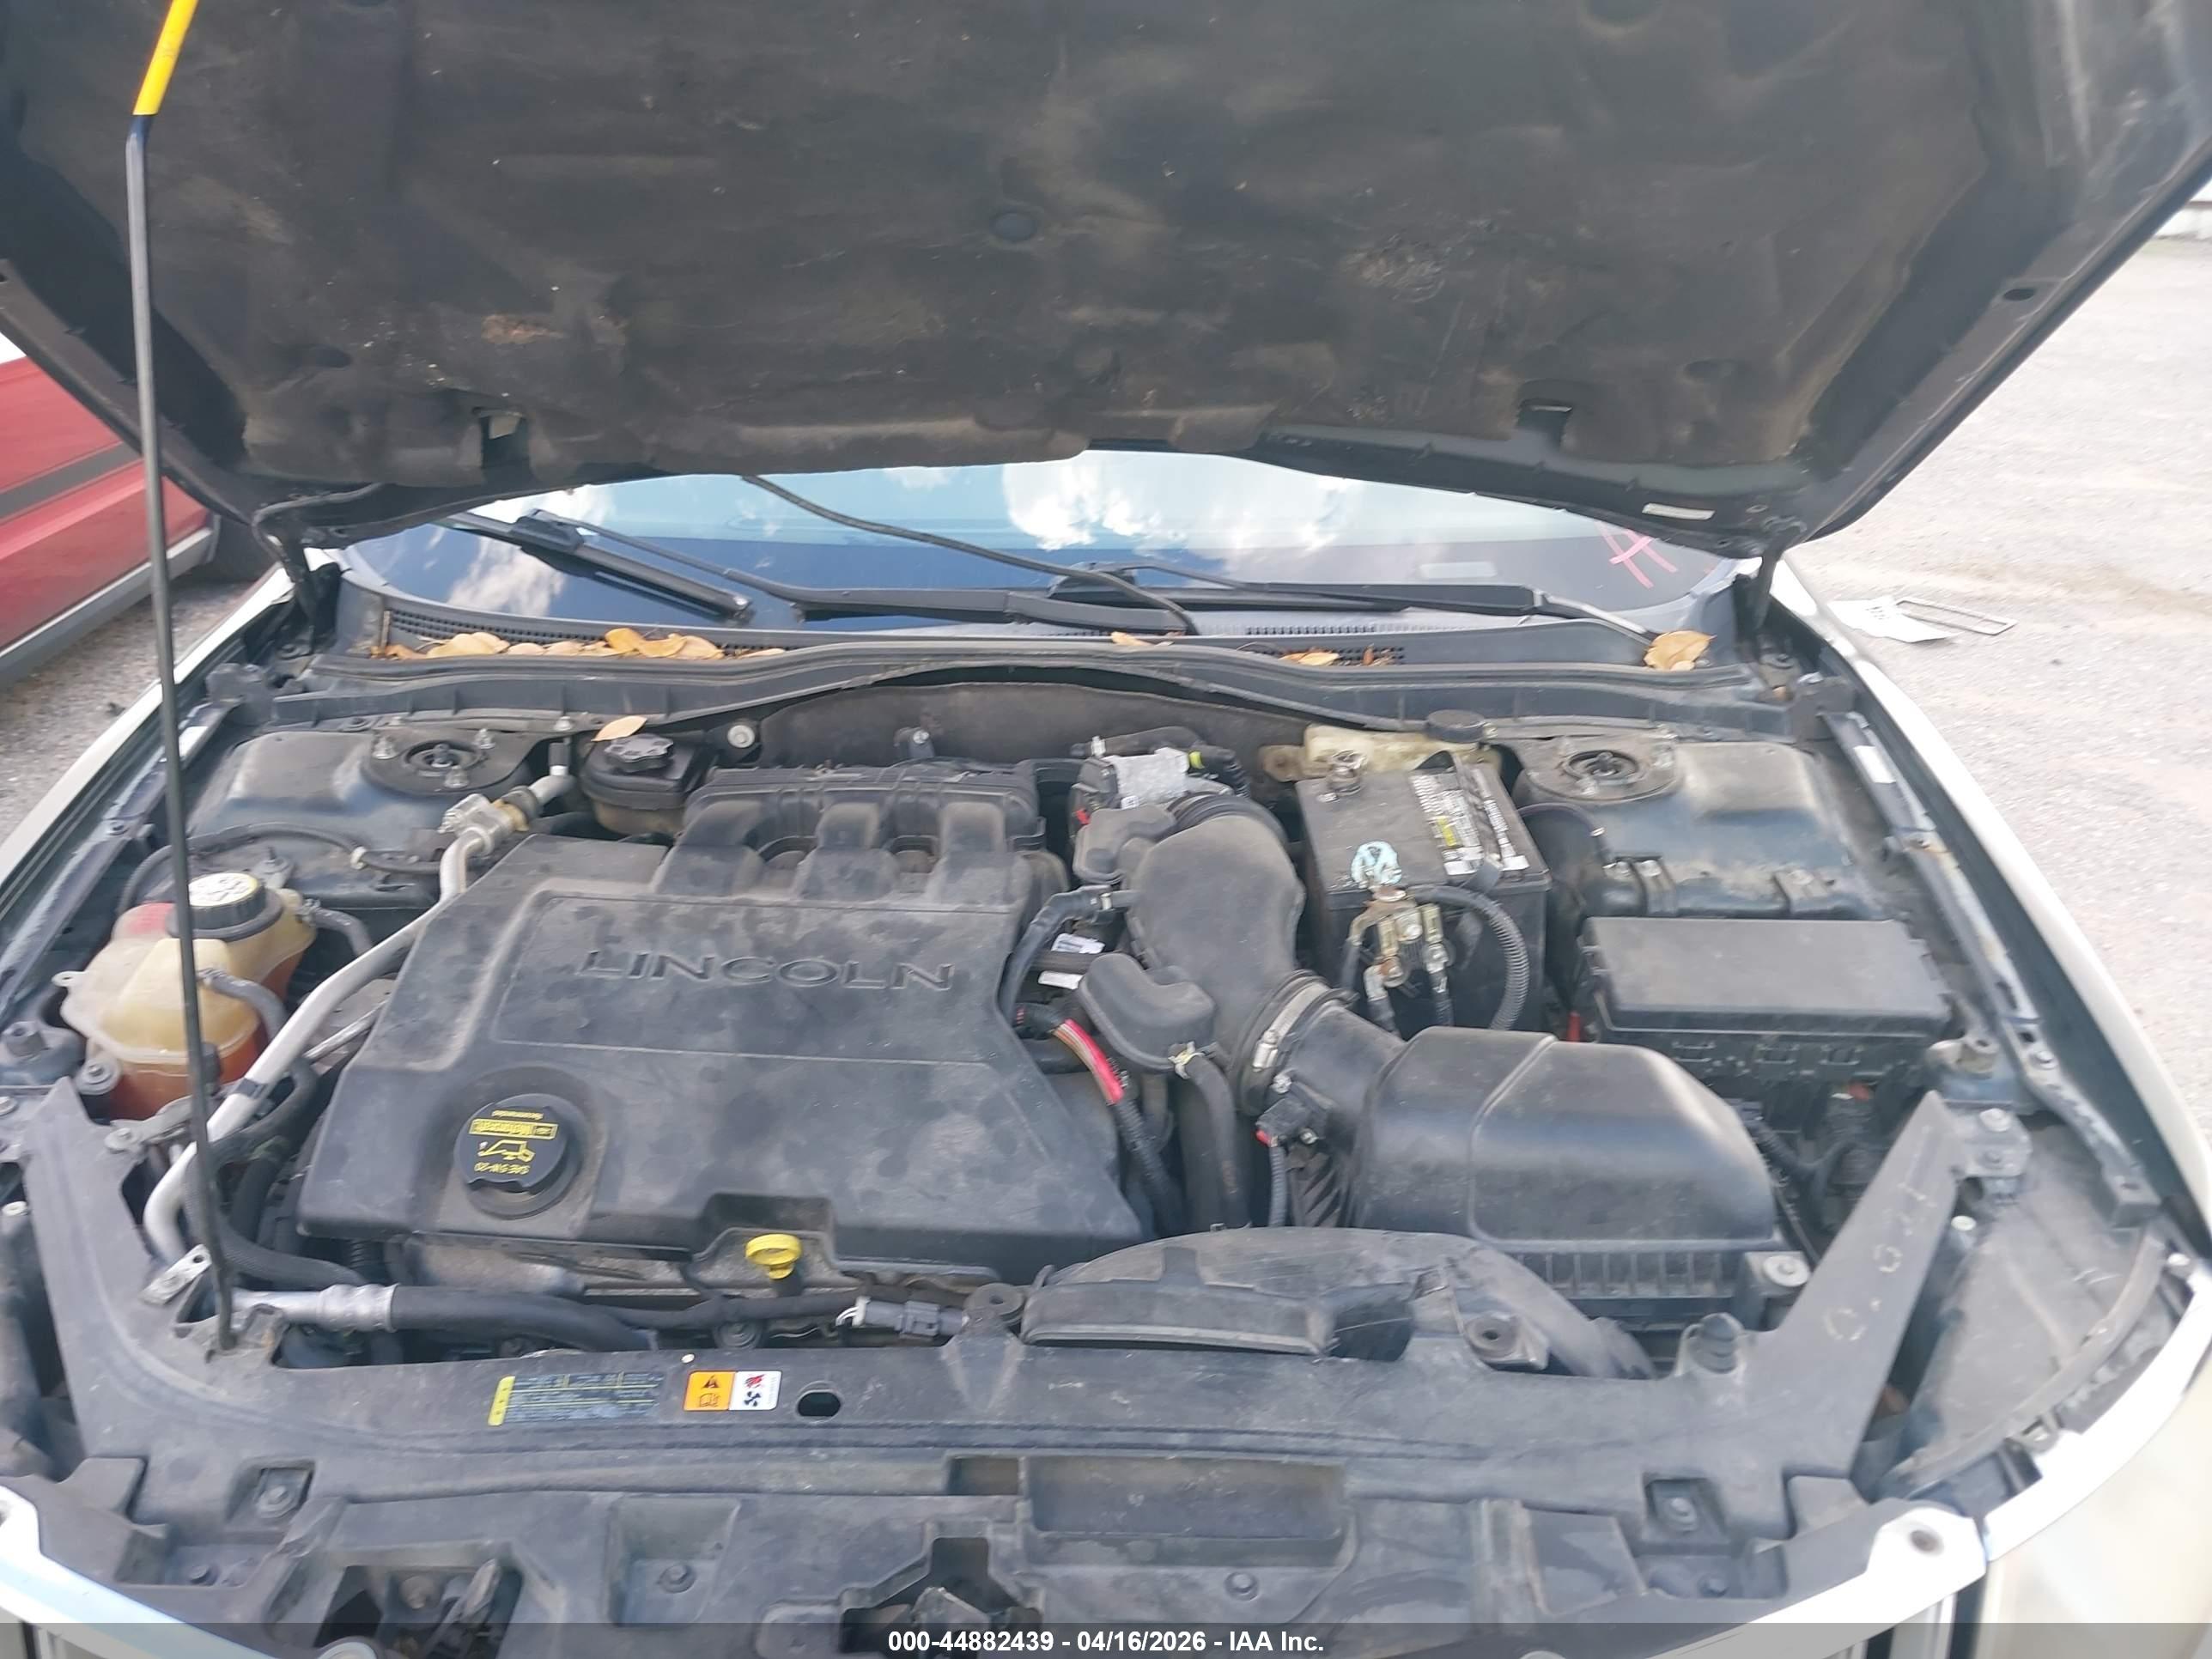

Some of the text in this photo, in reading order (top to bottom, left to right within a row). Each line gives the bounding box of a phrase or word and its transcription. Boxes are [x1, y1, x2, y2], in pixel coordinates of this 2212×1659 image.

[575, 949, 956, 991] LINCOLN
[474, 1162, 531, 1175] SAE 5W-20
